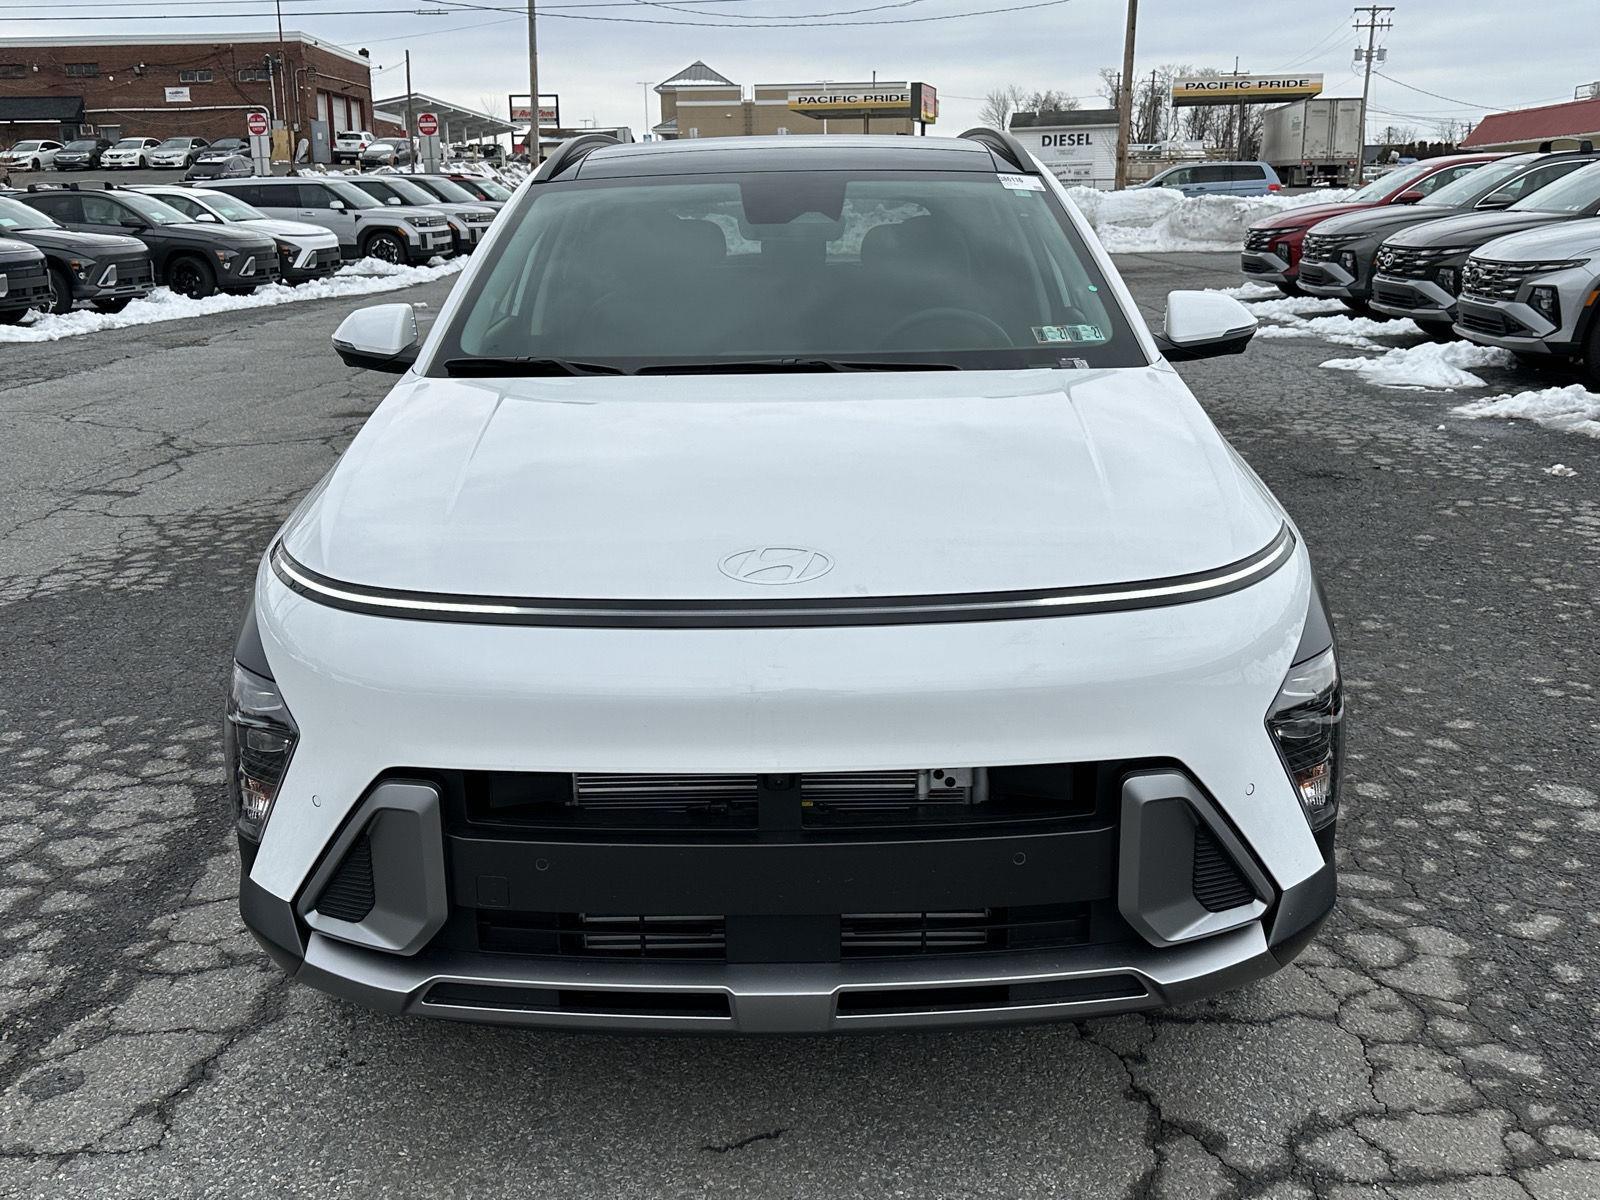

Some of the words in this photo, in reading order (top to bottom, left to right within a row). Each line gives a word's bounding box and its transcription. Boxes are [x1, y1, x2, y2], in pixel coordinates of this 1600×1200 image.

[1185, 80, 1251, 91] PACIFIC
[1258, 79, 1310, 89] PRIDE
[798, 95, 860, 105] PACIFIC
[863, 94, 910, 103] PRIDE
[1041, 133, 1093, 147] DIESEL
